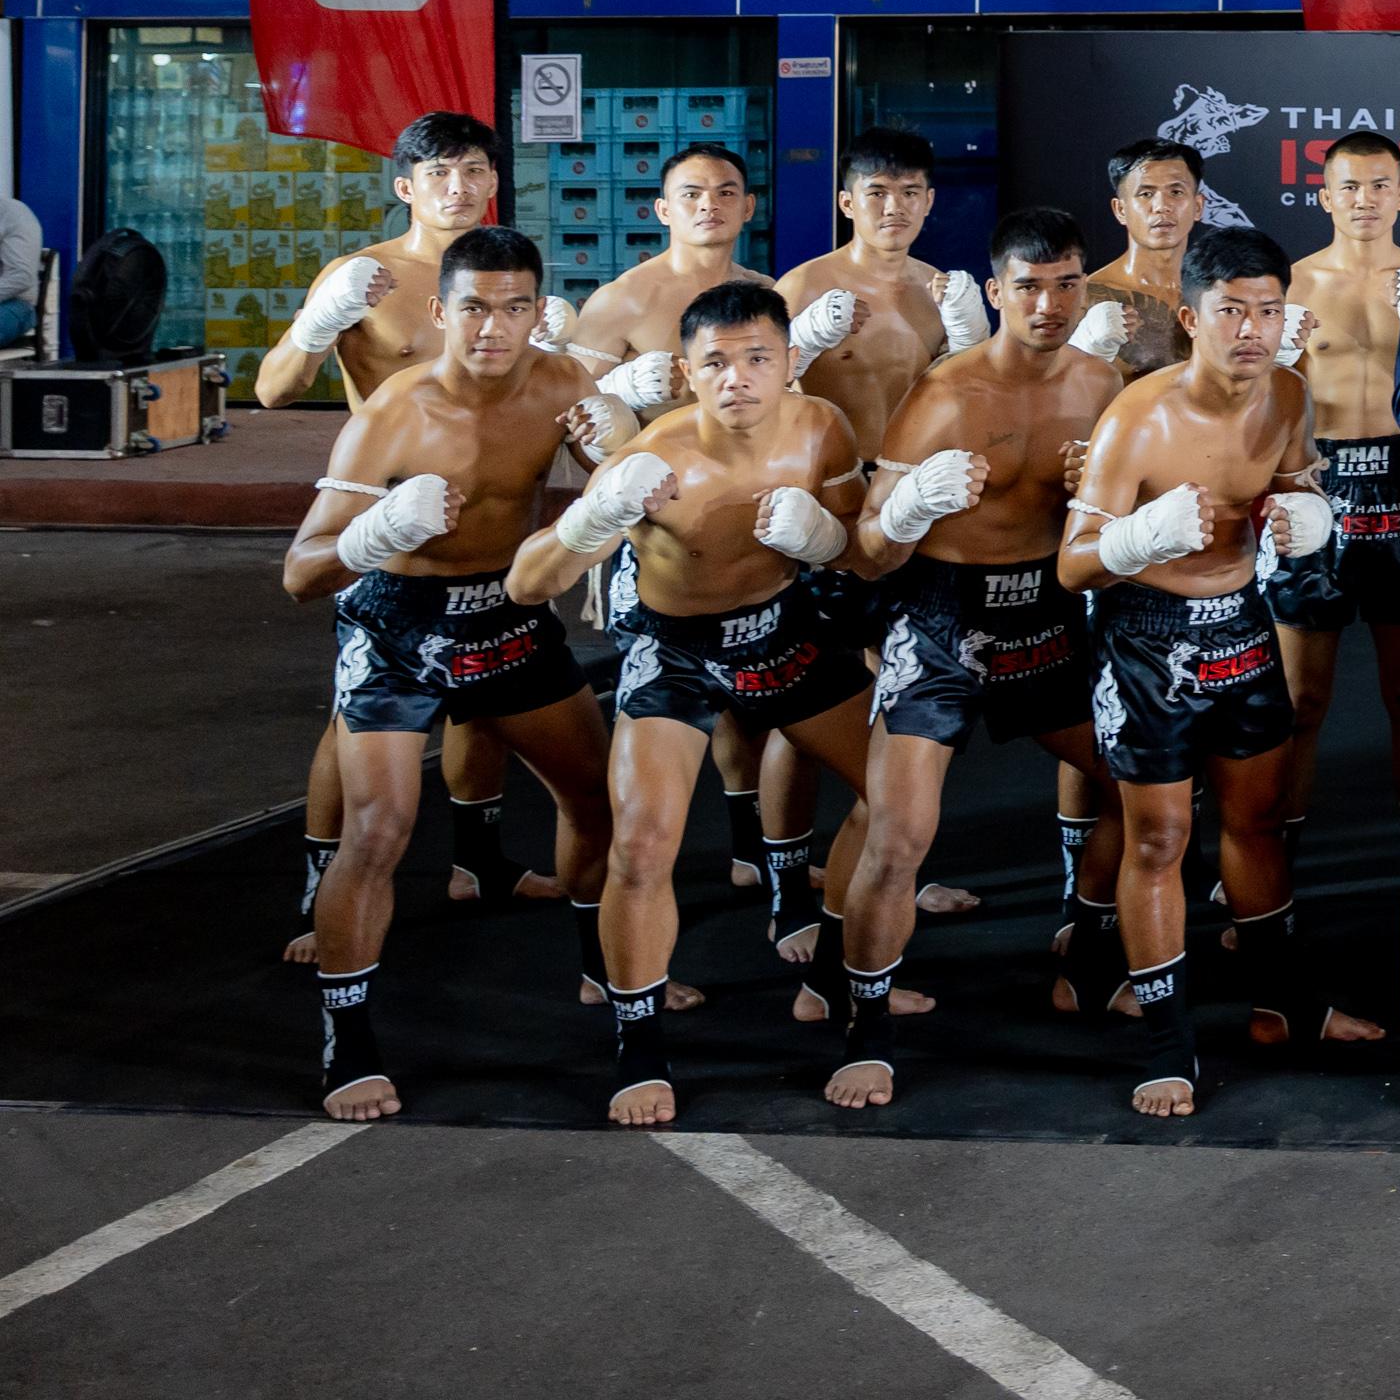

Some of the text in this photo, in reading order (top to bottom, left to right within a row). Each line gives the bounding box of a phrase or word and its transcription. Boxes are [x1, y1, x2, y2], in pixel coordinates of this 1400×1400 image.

[1336, 446, 1390, 463] THAI
[1338, 461, 1389, 472] FIGHT
[986, 570, 1041, 592] THAI
[986, 588, 1039, 602] FIGHT
[721, 602, 781, 635] THAI
[1189, 607, 1240, 622] FIGHT
[1197, 645, 1271, 681] ISUZU
[321, 981, 368, 999] THAI
[850, 976, 892, 991] THAI
[1133, 974, 1174, 996] THAI
[613, 996, 655, 1012] THAI
